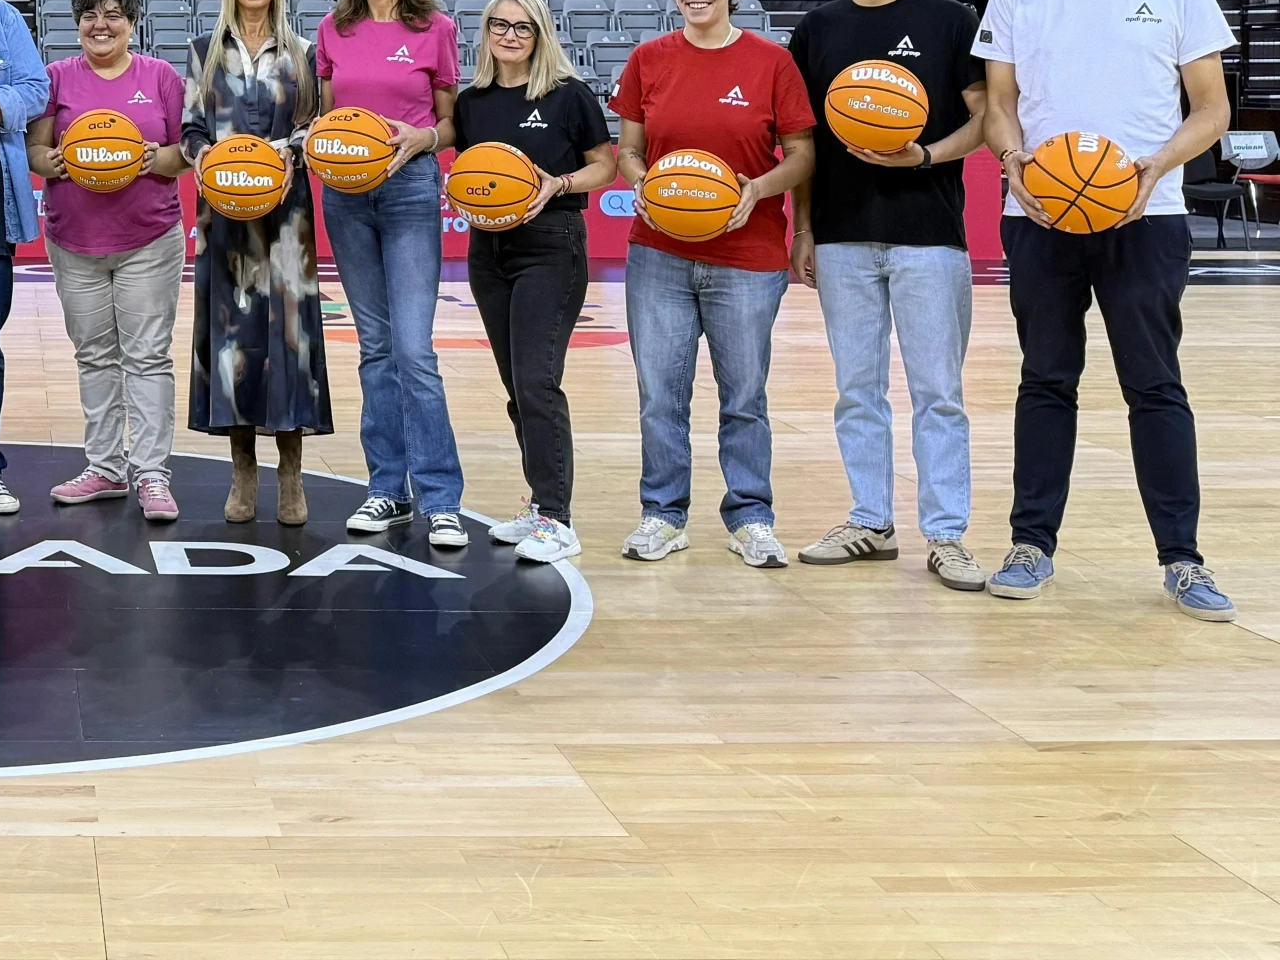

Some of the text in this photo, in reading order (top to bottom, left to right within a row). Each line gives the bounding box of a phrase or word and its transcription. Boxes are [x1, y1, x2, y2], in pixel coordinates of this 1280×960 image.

[851, 67, 918, 97] Wilson
[848, 97, 910, 118] liga endesa
[88, 120, 112, 130] acb
[329, 112, 353, 123] acb
[76, 147, 132, 163] Wilson
[229, 143, 253, 153] acb
[313, 138, 369, 157] Wilson
[658, 154, 722, 177] Wilson
[215, 170, 273, 187] Wilson
[466, 185, 491, 197] acb
[658, 186, 717, 199] liga endesa
[456, 205, 518, 225] Wilson
